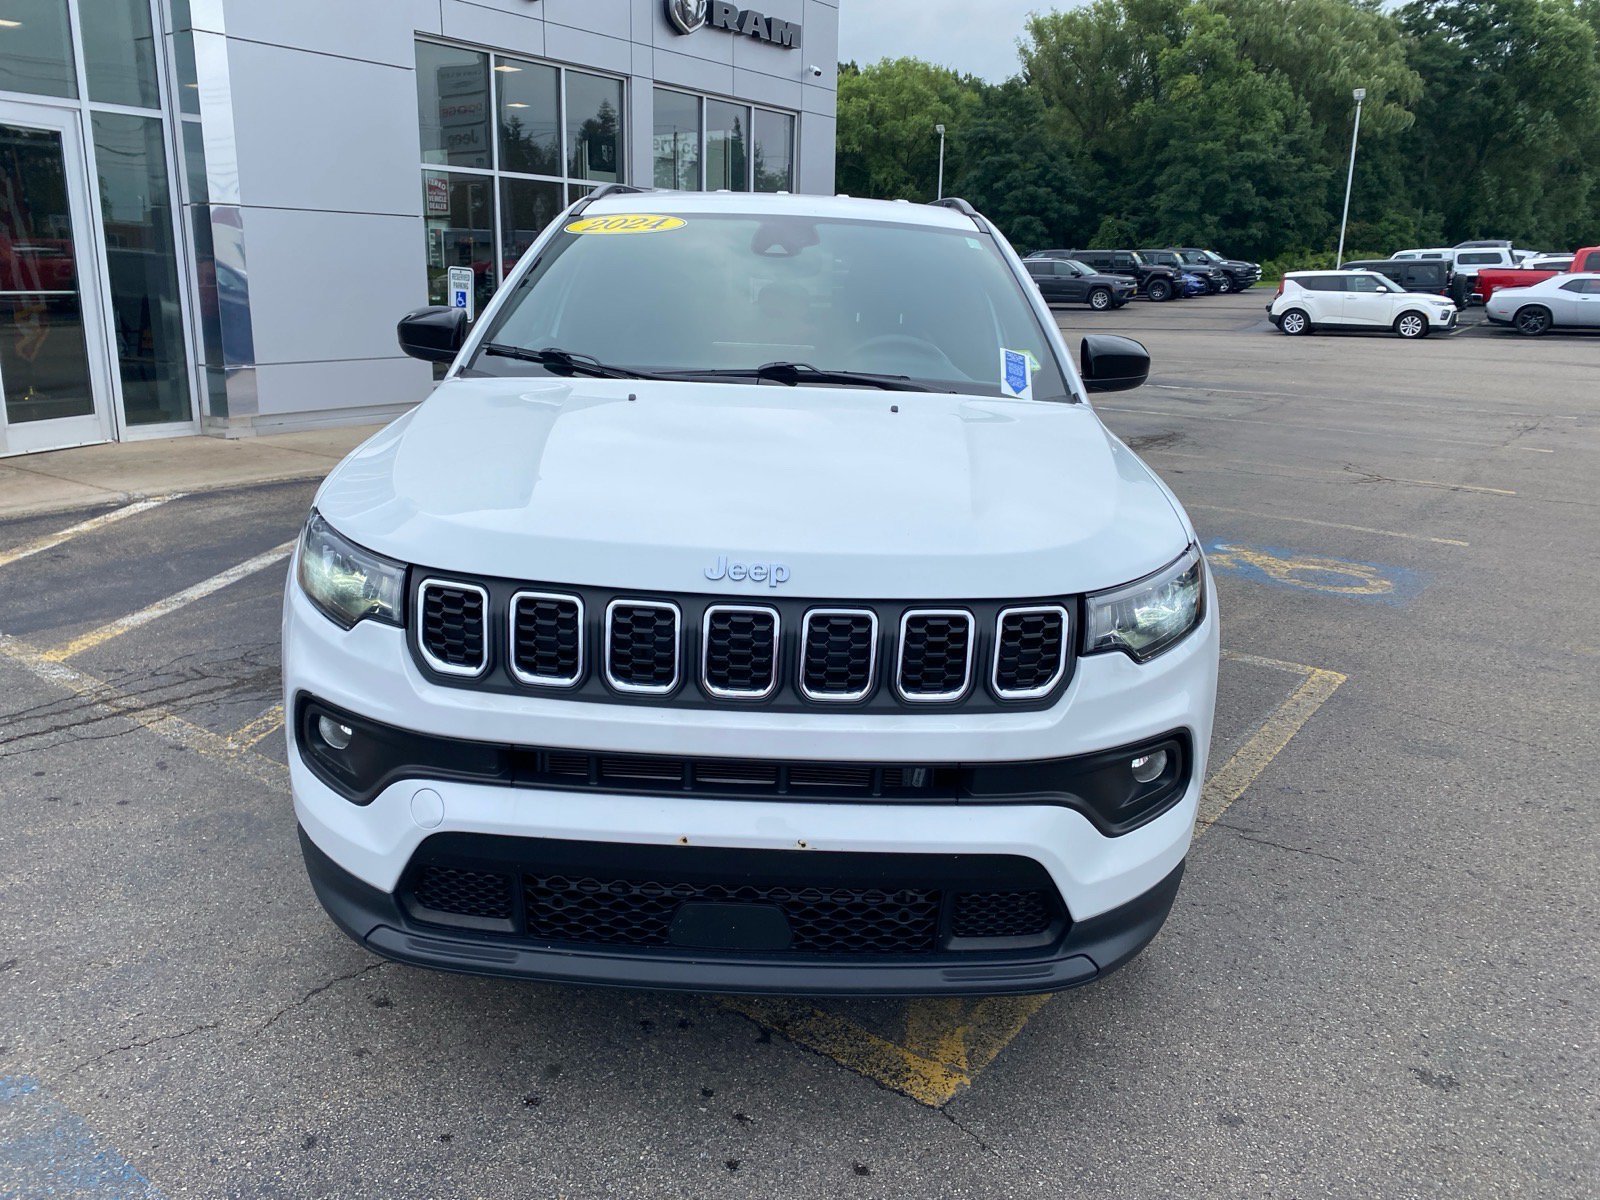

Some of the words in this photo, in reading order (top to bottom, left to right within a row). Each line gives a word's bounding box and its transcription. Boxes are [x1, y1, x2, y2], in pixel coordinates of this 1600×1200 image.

[707, 0, 801, 48] RAM
[429, 202, 447, 210] DEALER
[582, 217, 671, 232] 2024
[451, 273, 470, 281] RESERVED
[453, 282, 469, 290] PARKING
[704, 554, 790, 588] Jeep
